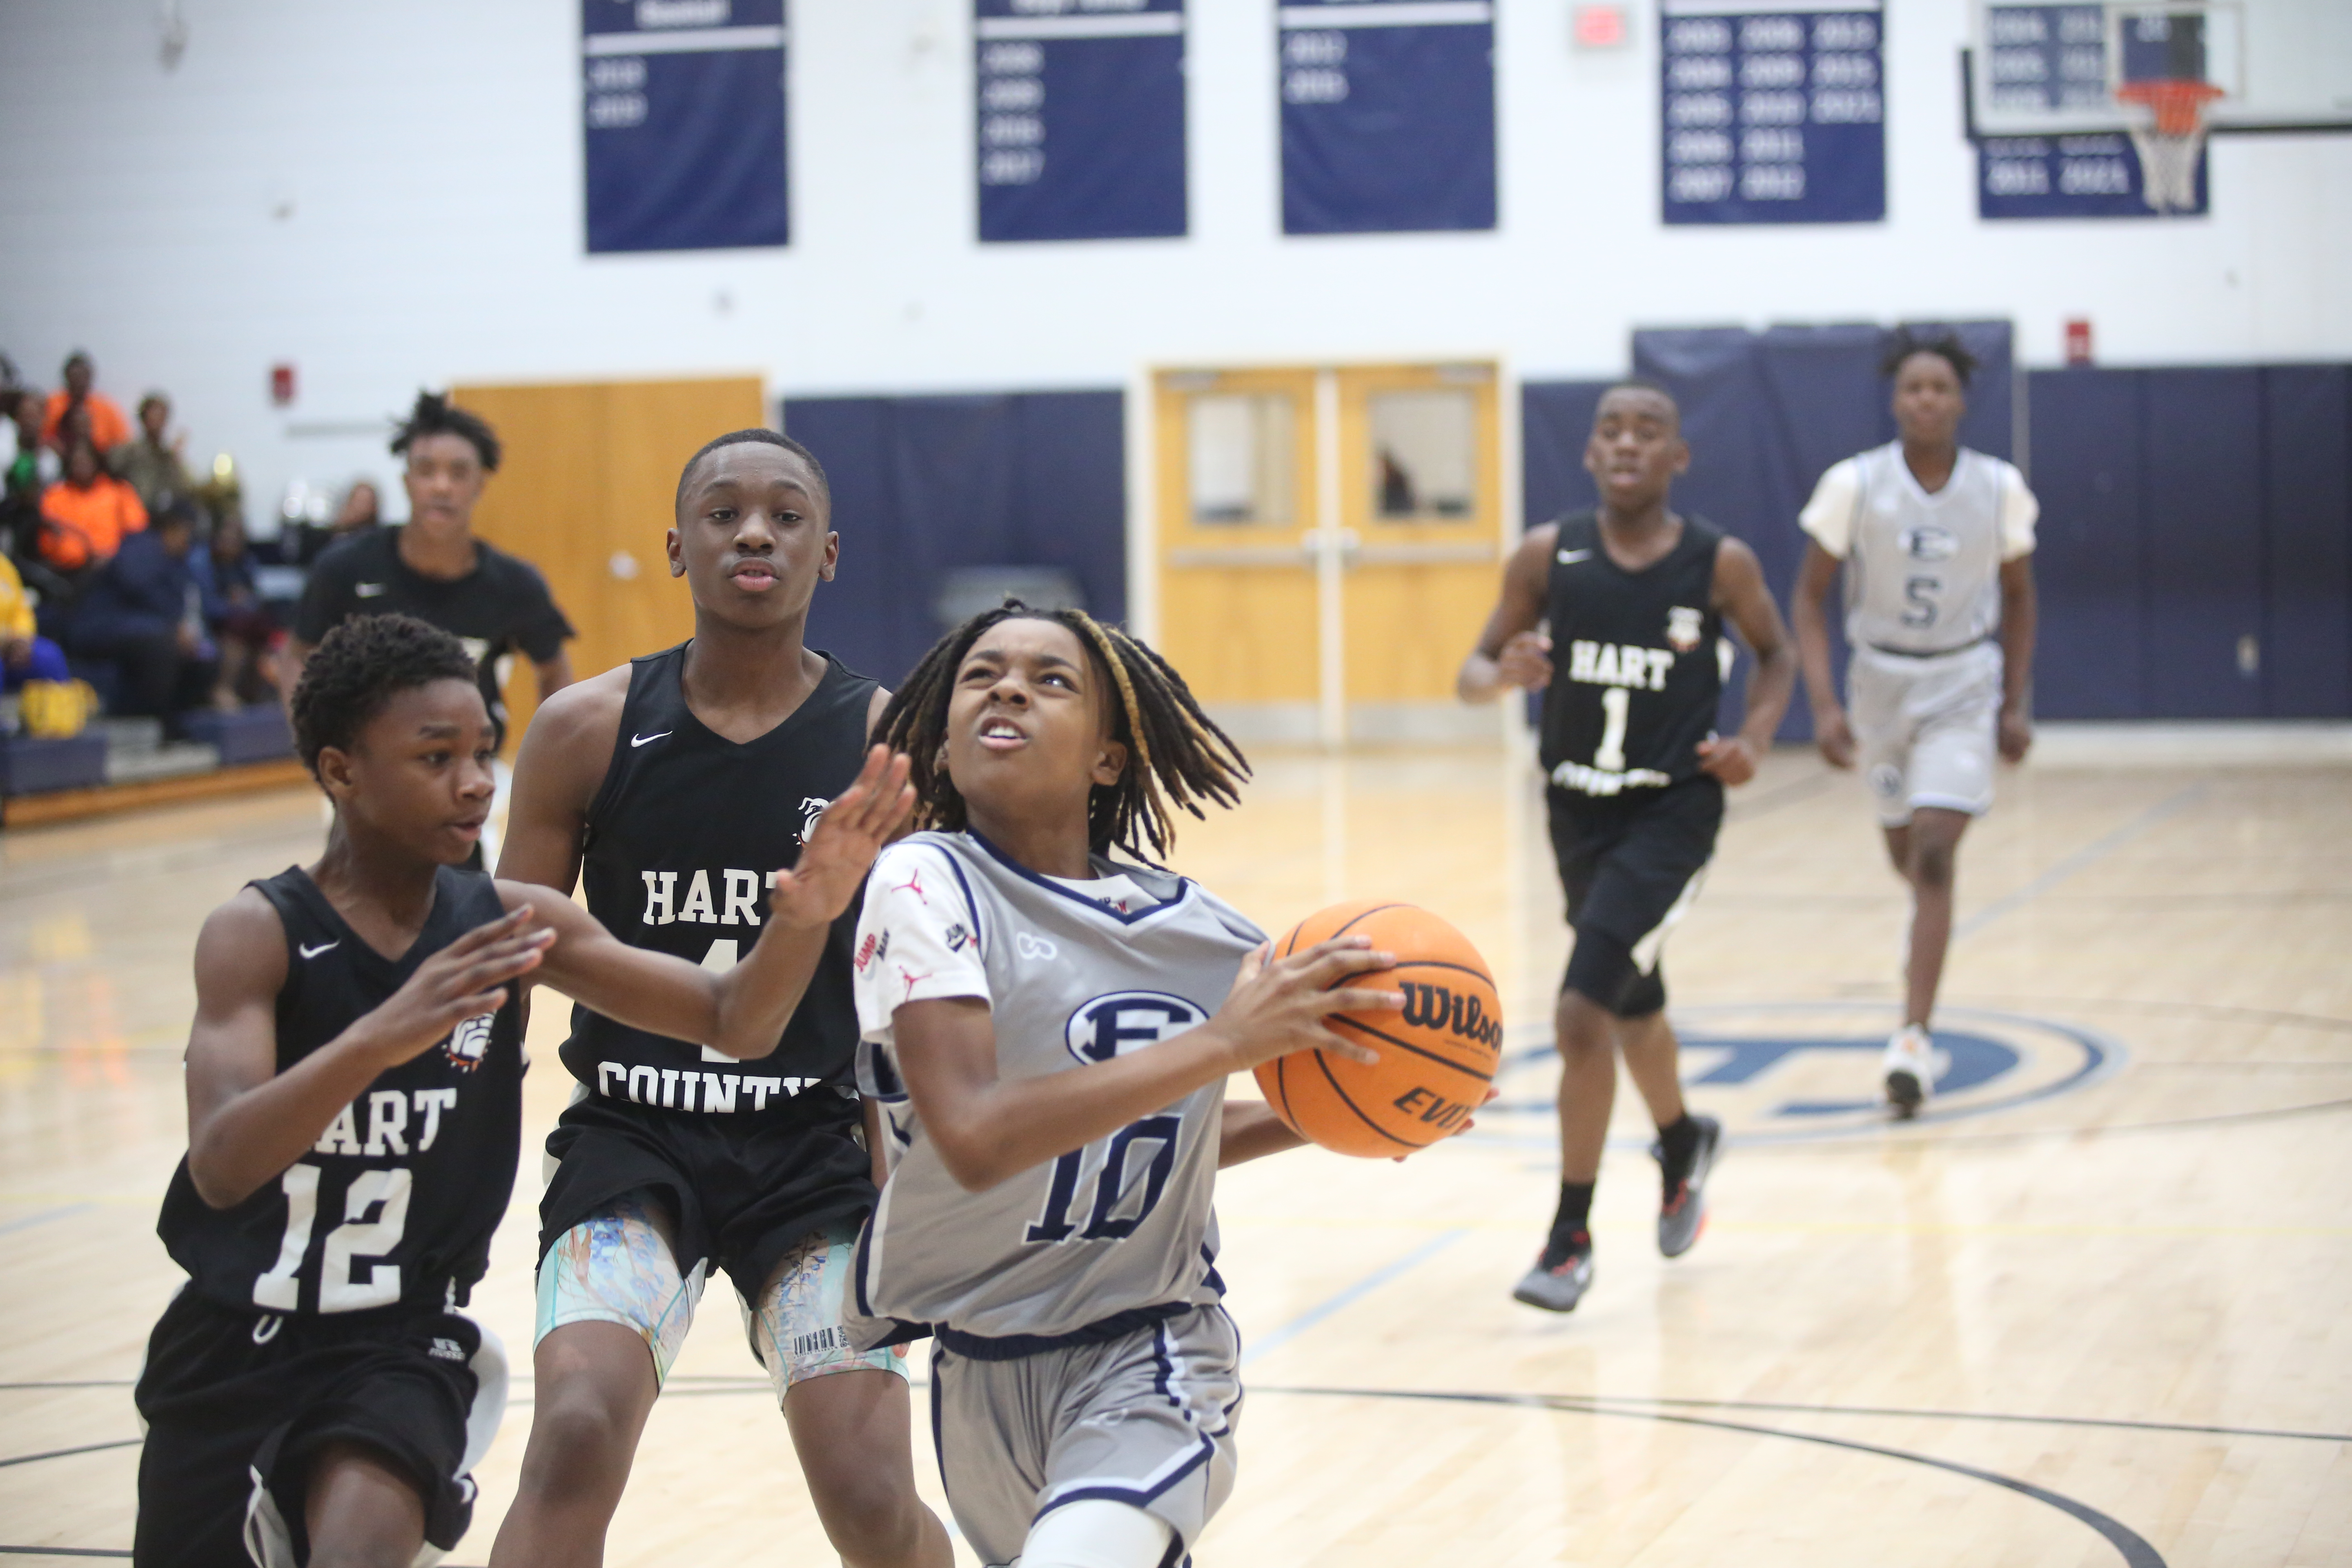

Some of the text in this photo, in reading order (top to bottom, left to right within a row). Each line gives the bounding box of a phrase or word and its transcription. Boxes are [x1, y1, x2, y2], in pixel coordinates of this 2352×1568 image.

[1569, 639, 1675, 691] HART
[1595, 686, 1630, 771] 1
[1399, 980, 1503, 1051] Wilso
[314, 1087, 457, 1156] ART
[1024, 1113, 1184, 1245] 10
[253, 1163, 412, 1314] 12
